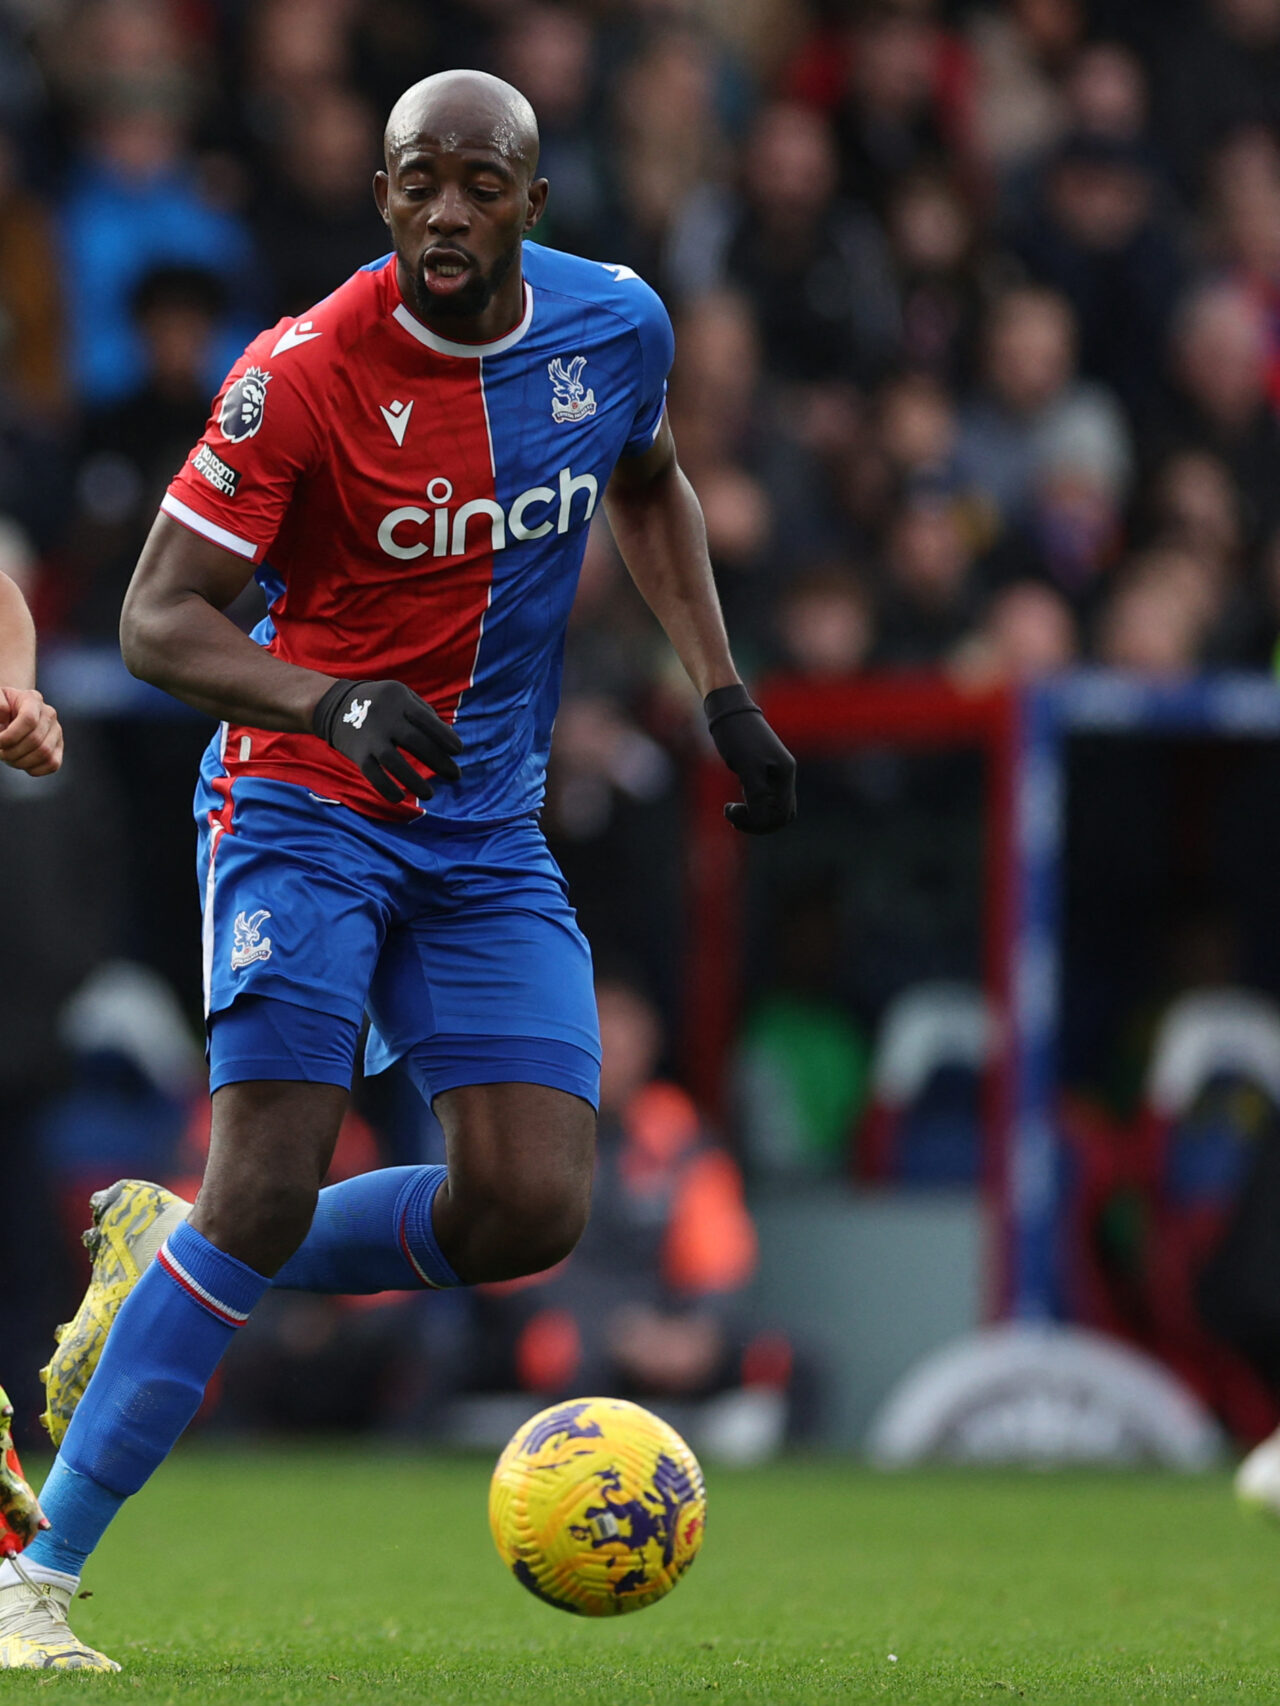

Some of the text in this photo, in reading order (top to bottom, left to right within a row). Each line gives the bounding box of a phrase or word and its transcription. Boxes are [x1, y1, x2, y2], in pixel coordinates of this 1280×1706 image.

[191, 454, 236, 497] for racism
[198, 443, 235, 483] No room
[377, 466, 598, 560] cinch
